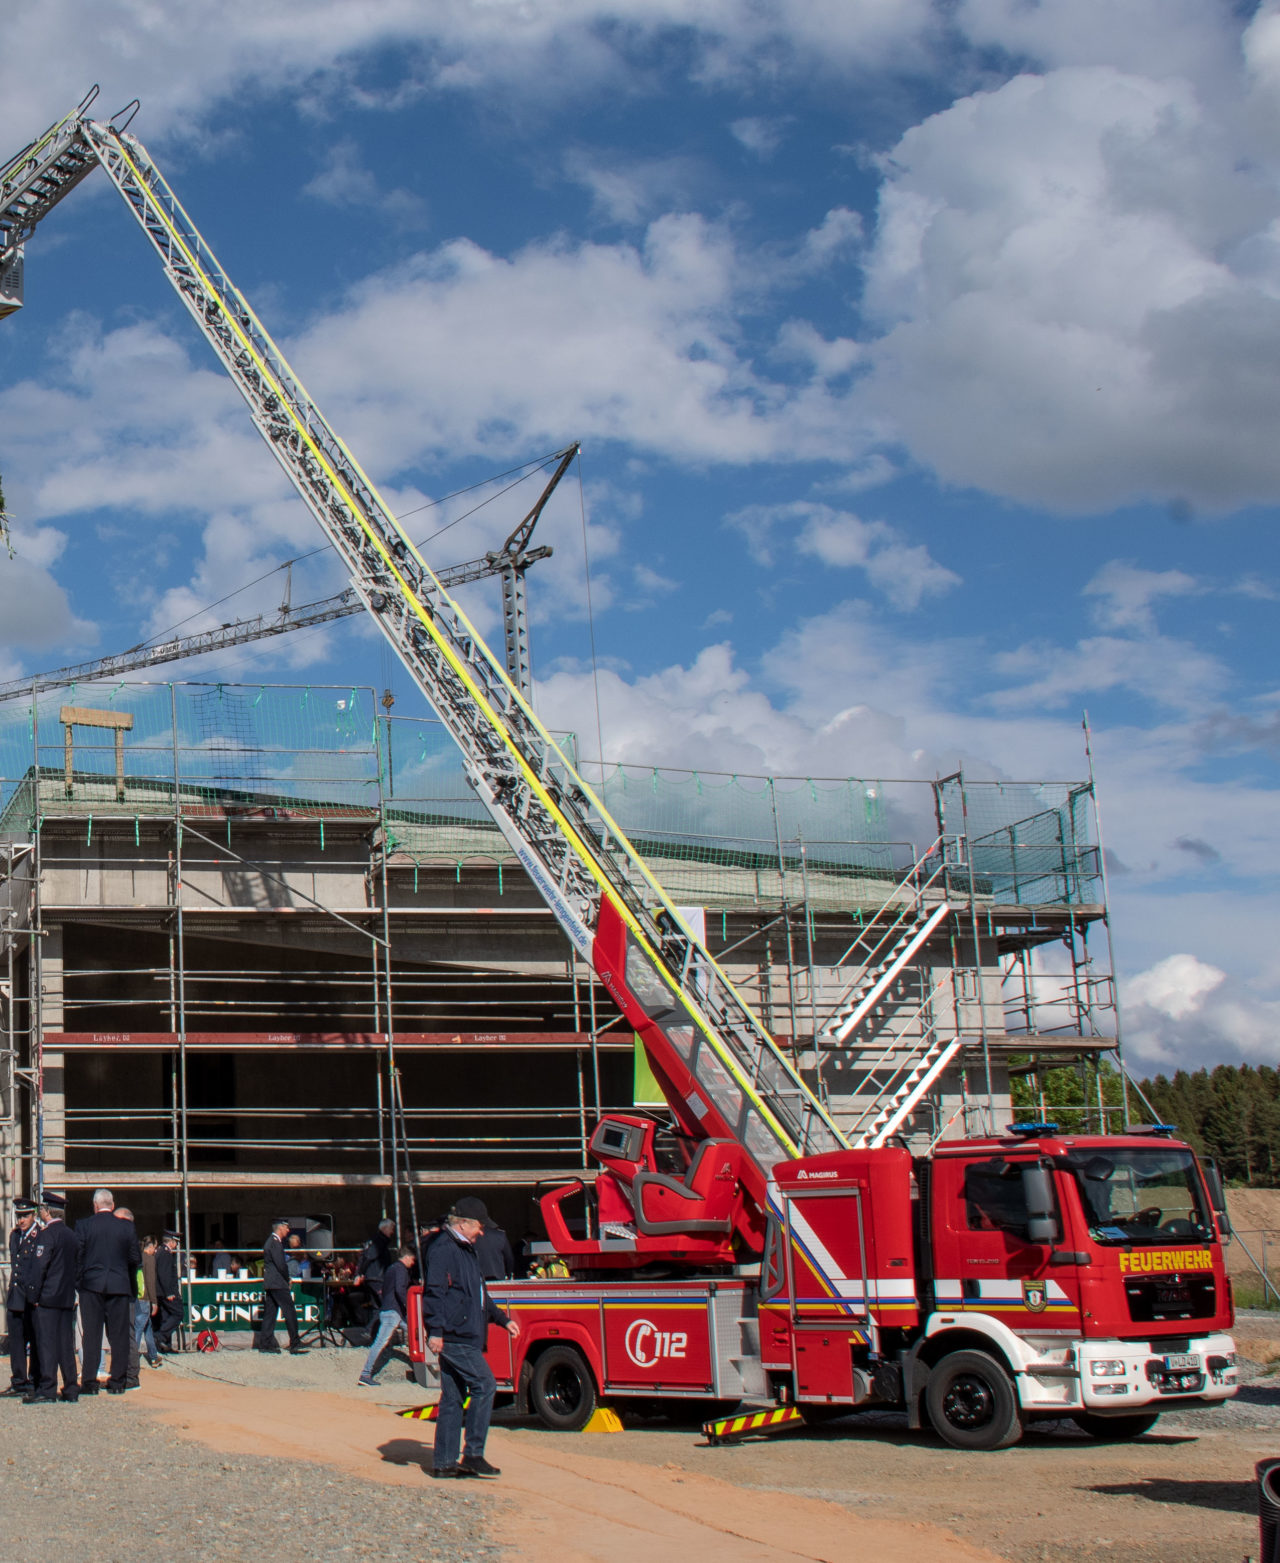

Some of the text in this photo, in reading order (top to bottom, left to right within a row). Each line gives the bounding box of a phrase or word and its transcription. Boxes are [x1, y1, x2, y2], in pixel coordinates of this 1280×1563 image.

[518, 847, 588, 947] www.feuerwehr-lengenfeld.de
[1119, 1250, 1213, 1272] FEUERWEHR
[654, 1332, 687, 1357] 112
